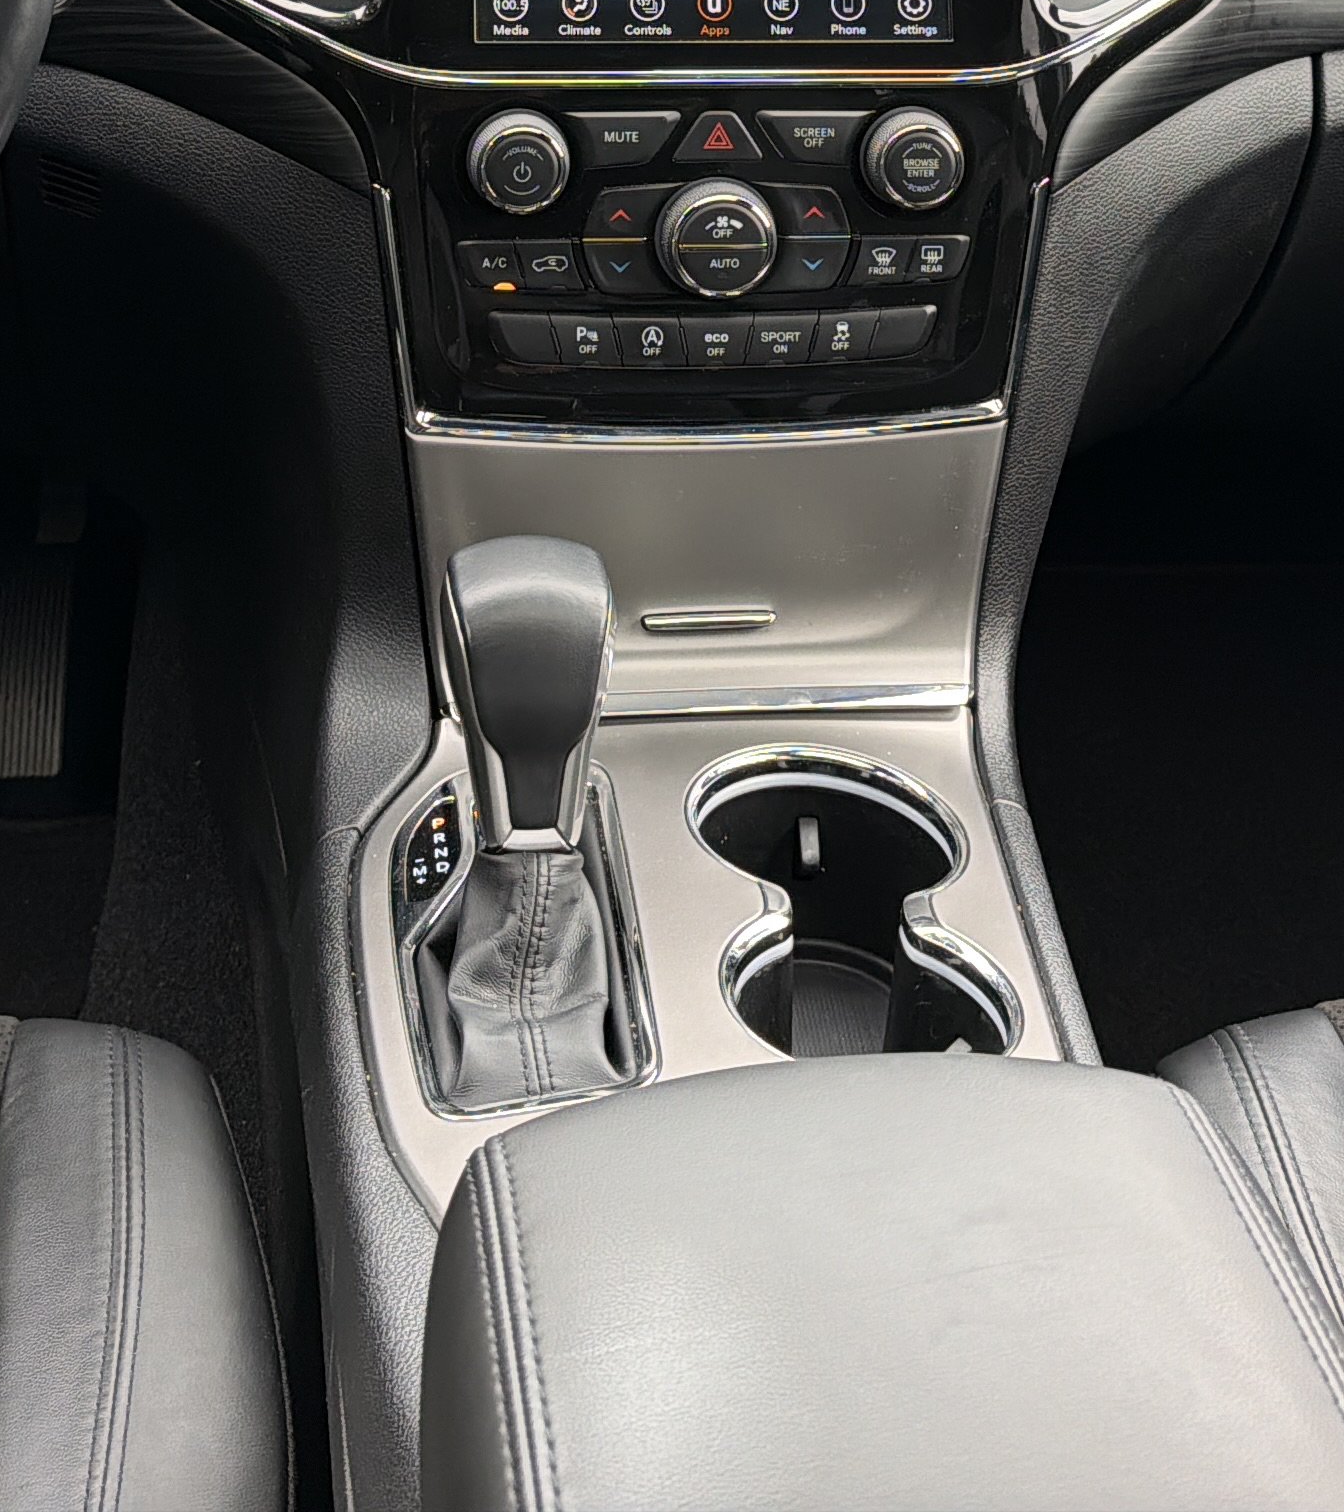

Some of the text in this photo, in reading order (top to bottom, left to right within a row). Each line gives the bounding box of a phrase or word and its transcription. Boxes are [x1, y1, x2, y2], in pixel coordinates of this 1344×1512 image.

[495, 0, 527, 11] 100.5
[493, 24, 529, 36] Media
[558, 24, 602, 36] Climate
[624, 24, 672, 36] Controls
[699, 25, 730, 39] Apps
[770, 25, 794, 36] Nav
[830, 24, 867, 36] Phone
[893, 24, 938, 39] Settings
[604, 131, 640, 145] MUTE
[793, 126, 836, 140] SCREEN
[803, 134, 825, 148] OFF
[903, 158, 941, 168] BROWSE
[907, 169, 935, 178] ENTER
[712, 228, 734, 239] OFF
[481, 257, 507, 270] A/C
[709, 257, 740, 270] AUTO
[920, 263, 943, 274] REAR
[868, 265, 897, 276] FRONT
[704, 333, 729, 344] eco
[760, 331, 801, 344] SPORT
[578, 343, 597, 355] OFF
[642, 344, 661, 356] OFF
[706, 345, 726, 357] OFF
[773, 343, 789, 354] ON
[831, 340, 850, 351] OFF
[431, 817, 446, 830] P
[433, 832, 446, 844] R
[434, 846, 449, 858] N
[436, 861, 450, 874] D
